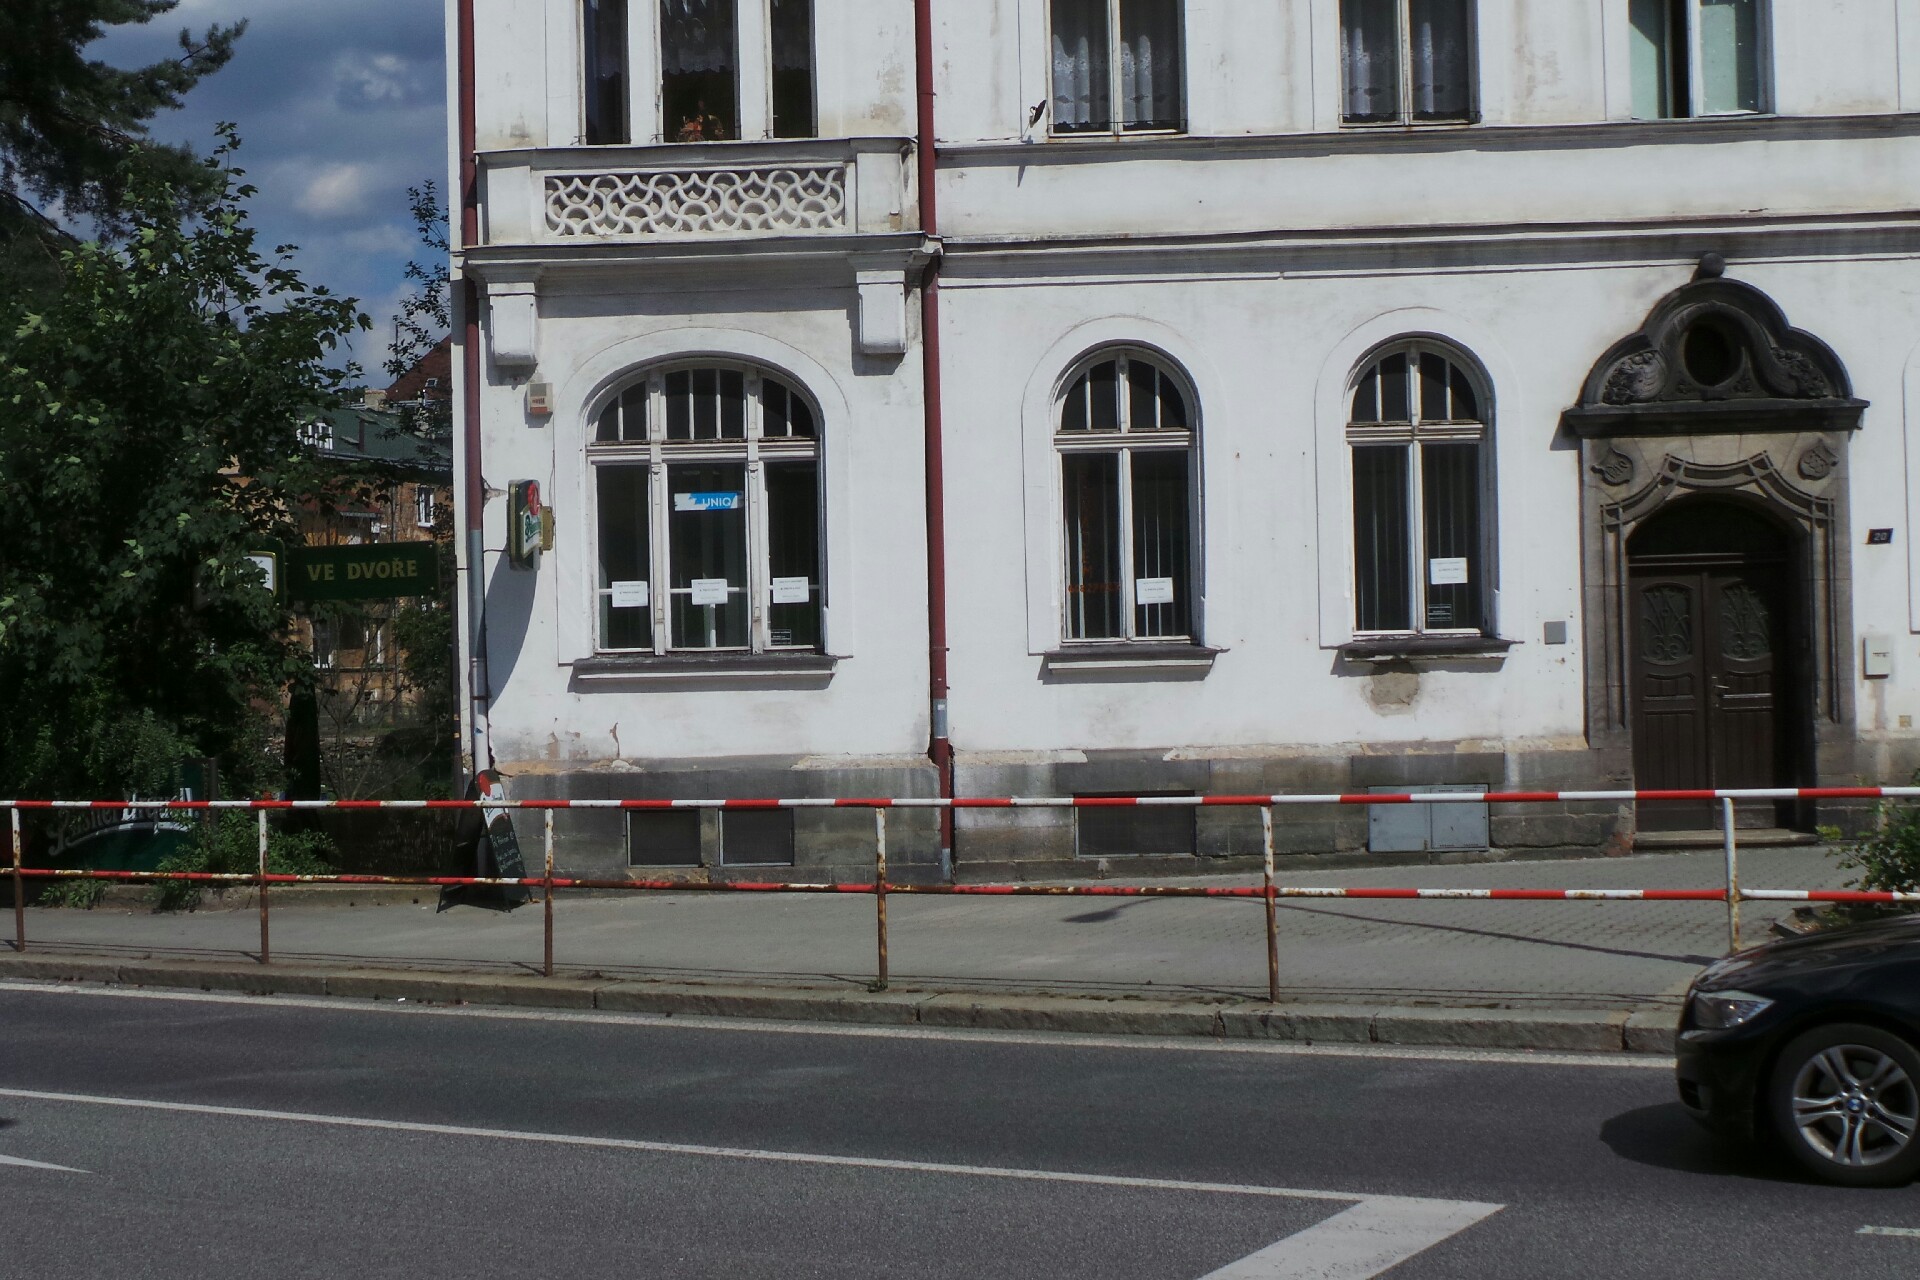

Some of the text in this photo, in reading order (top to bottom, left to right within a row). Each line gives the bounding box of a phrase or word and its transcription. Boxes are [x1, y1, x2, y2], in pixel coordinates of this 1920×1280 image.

[1874, 532, 1888, 541] 20
[306, 557, 418, 582] VE DVOŘE
